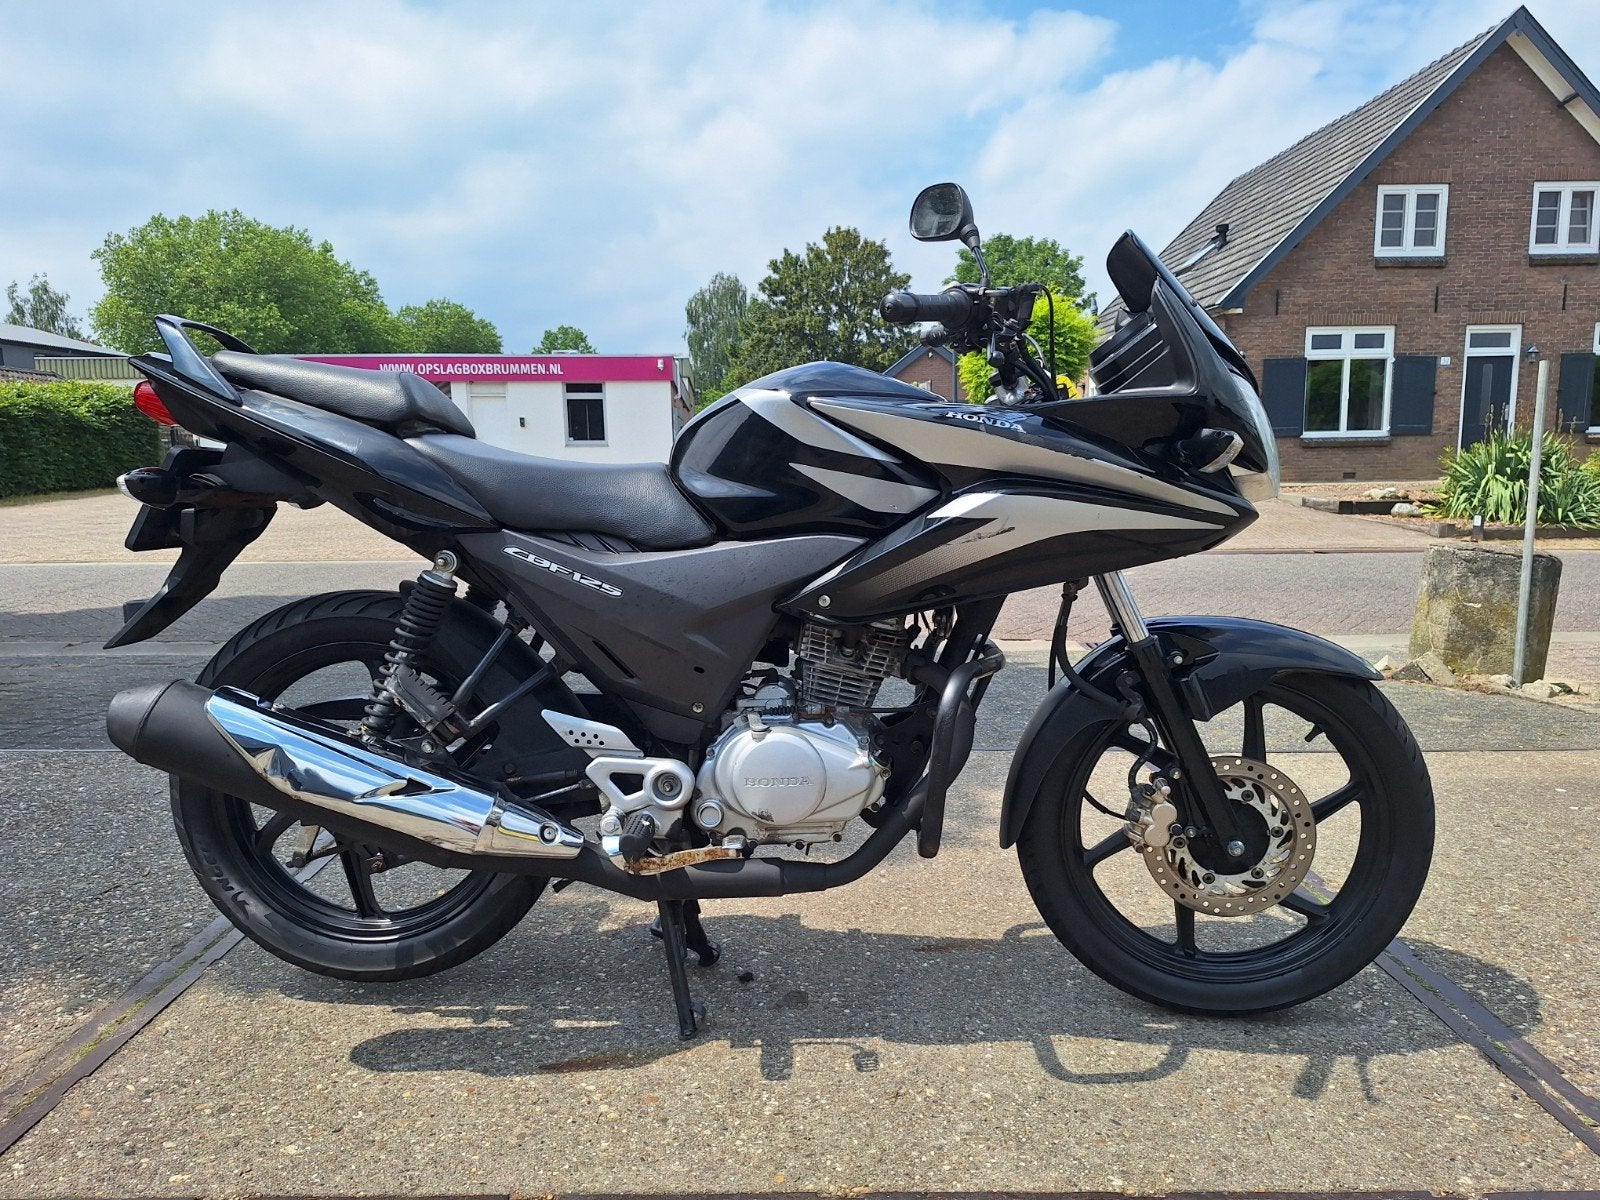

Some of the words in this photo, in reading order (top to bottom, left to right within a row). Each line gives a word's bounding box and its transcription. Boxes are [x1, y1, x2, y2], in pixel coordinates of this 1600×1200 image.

[945, 411, 1027, 434] HONDA
[502, 546, 624, 597] CBF125
[743, 776, 814, 788] HONDA
